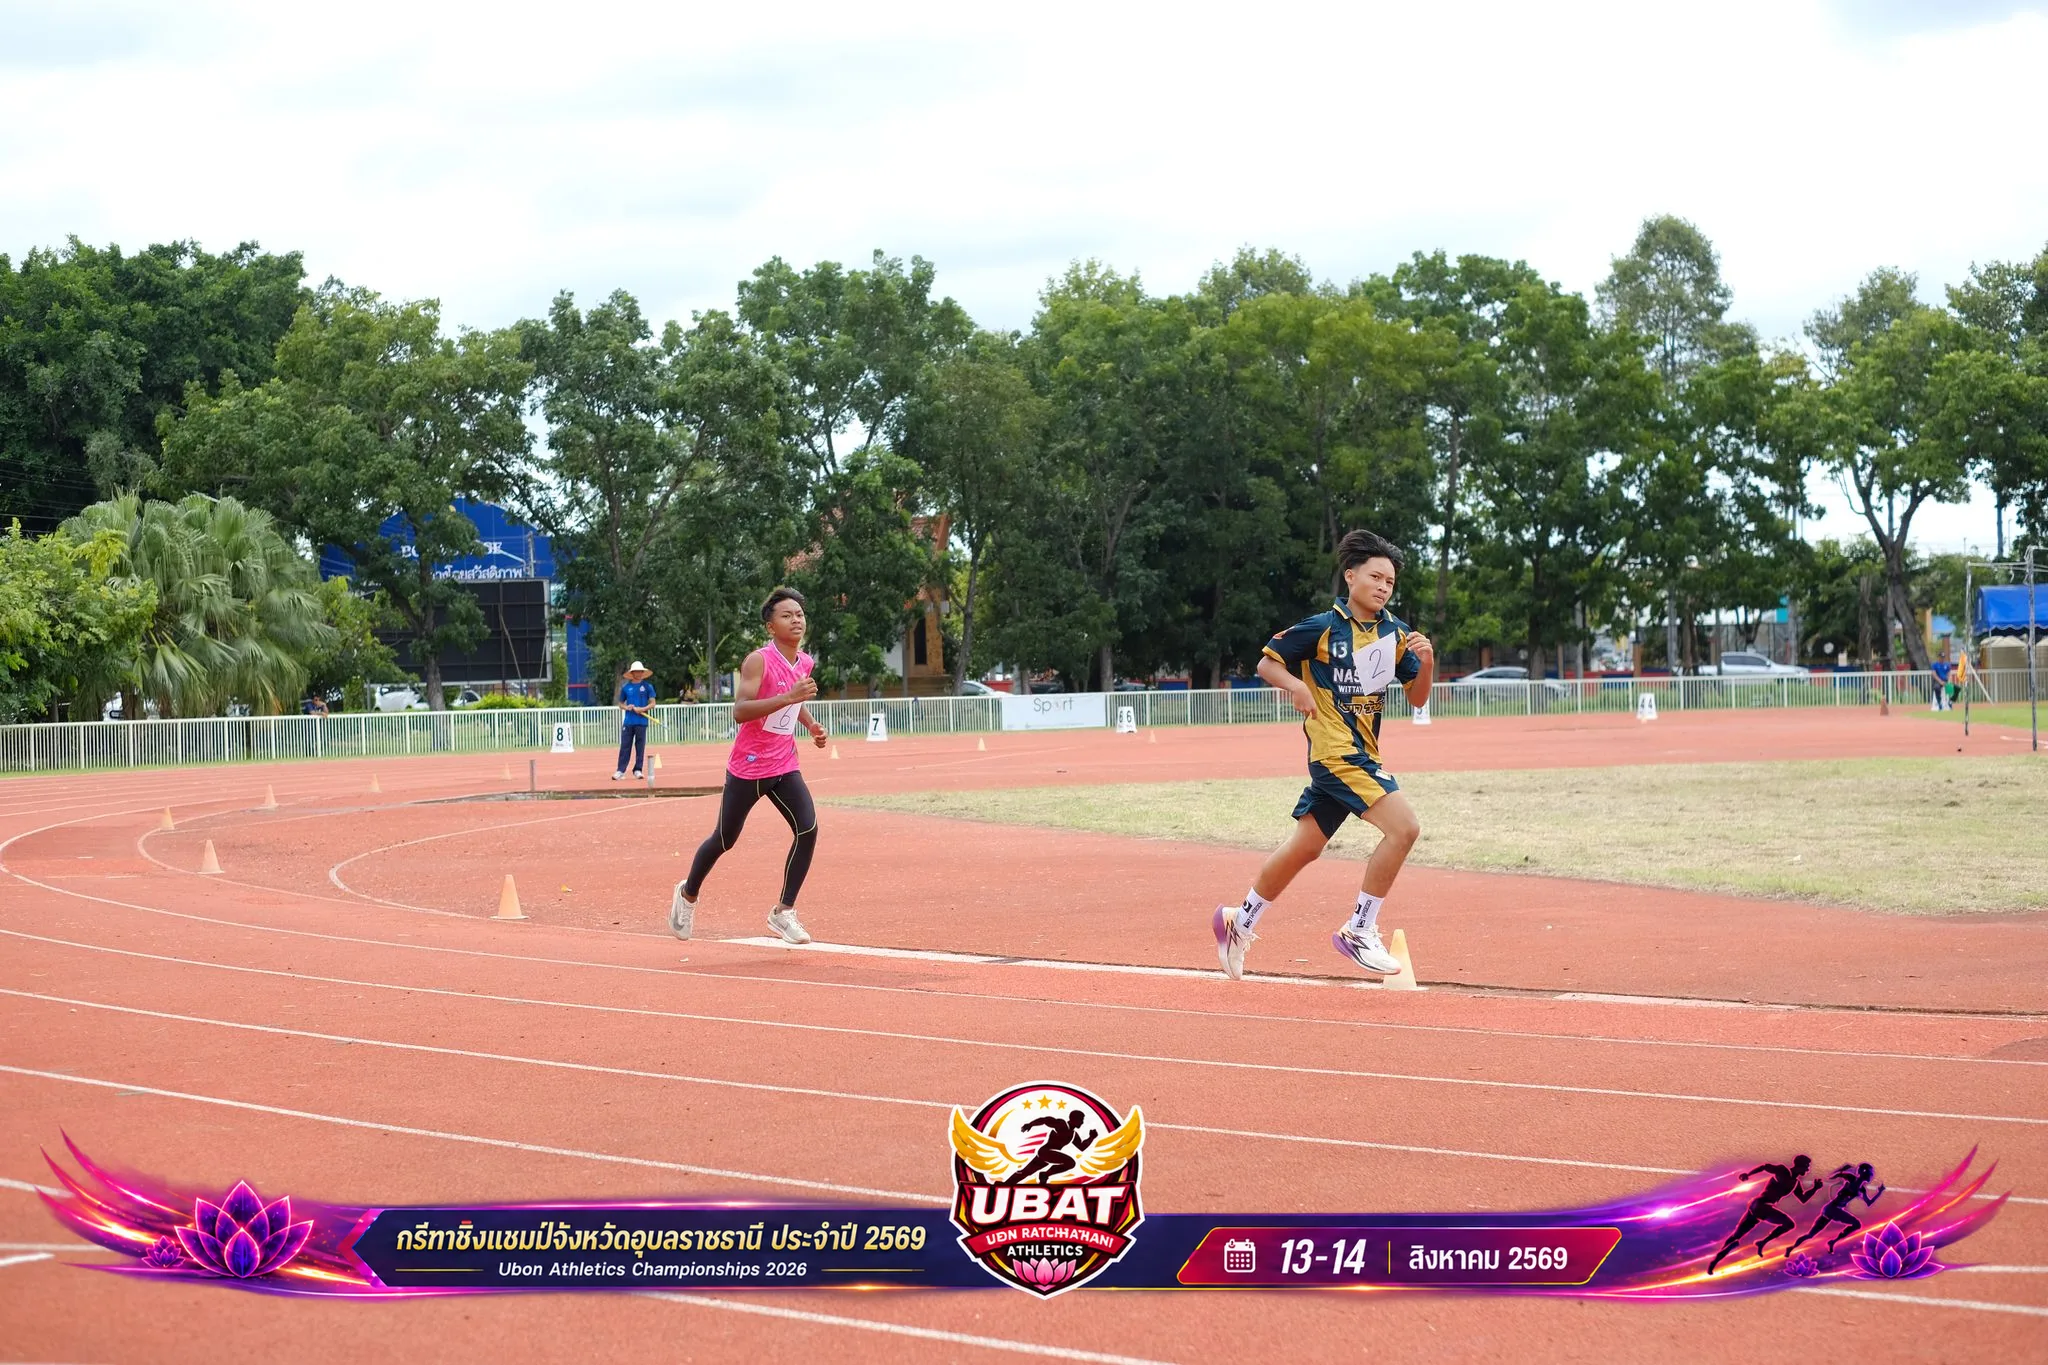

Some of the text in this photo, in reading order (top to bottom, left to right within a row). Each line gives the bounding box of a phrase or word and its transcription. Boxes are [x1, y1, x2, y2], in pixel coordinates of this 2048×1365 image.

[1332, 640, 1348, 659] 13
[1369, 648, 1387, 679] 2
[780, 703, 791, 728] 6
[1119, 710, 1124, 724] 6
[1126, 710, 1132, 723] 6
[872, 717, 880, 732] 7
[556, 727, 564, 742] 8
